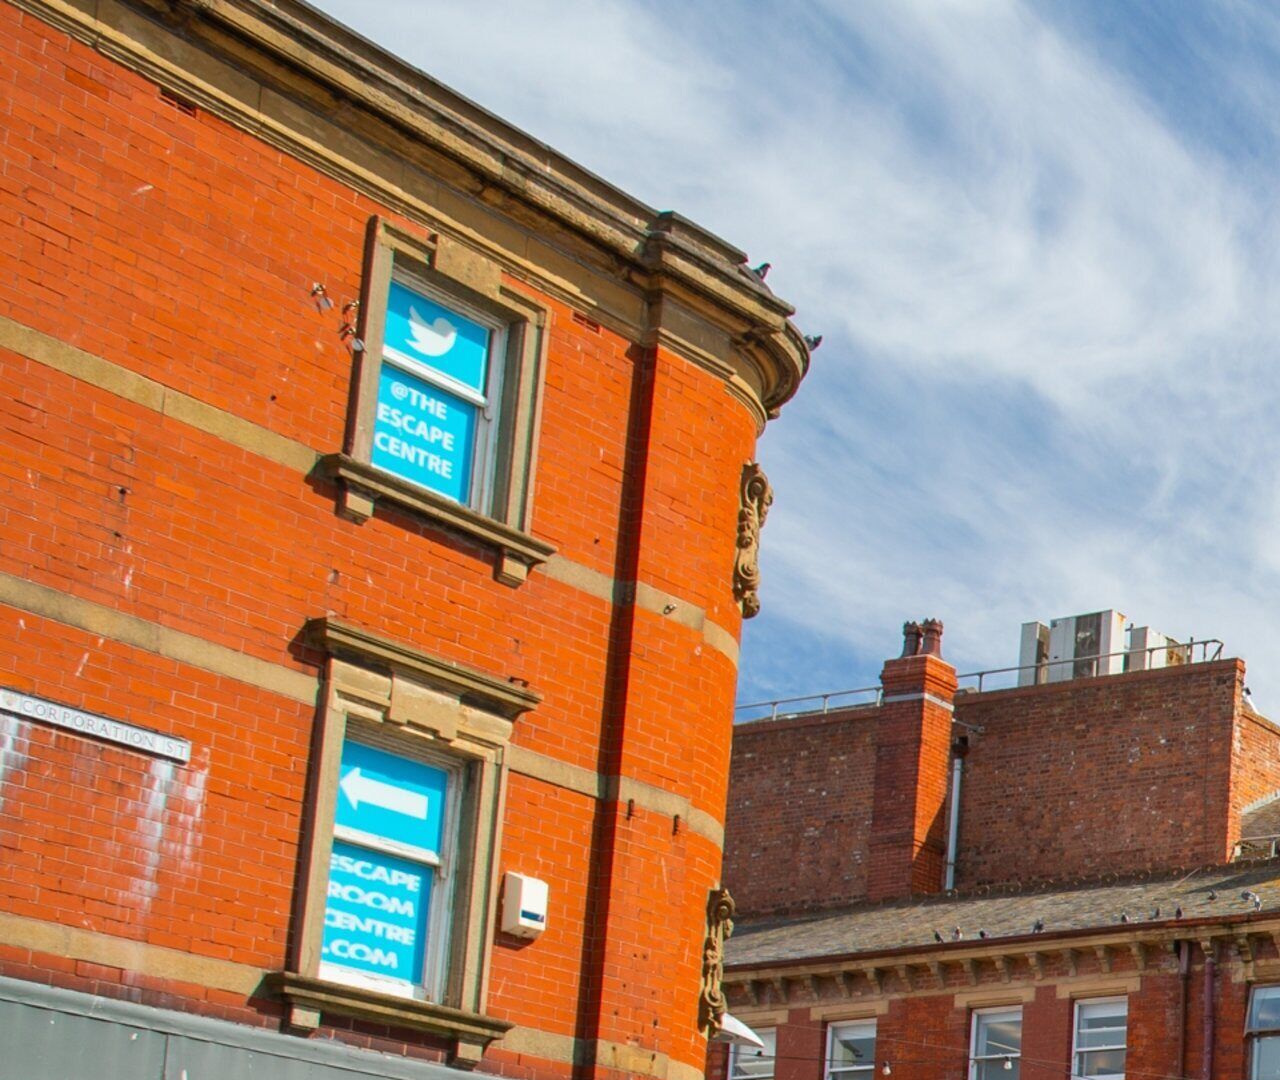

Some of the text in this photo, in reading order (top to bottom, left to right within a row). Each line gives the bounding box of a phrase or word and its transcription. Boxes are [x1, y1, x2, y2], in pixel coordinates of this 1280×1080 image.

[390, 381, 448, 420] @THE
[377, 402, 454, 451] ESCAPE
[374, 431, 452, 479] CENTRE
[22, 699, 186, 758] CORPORATION ST
[330, 853, 421, 892] ESCAPE
[327, 880, 415, 918] ROOM
[325, 907, 415, 946] CENTRE
[322, 938, 398, 969] .COM
